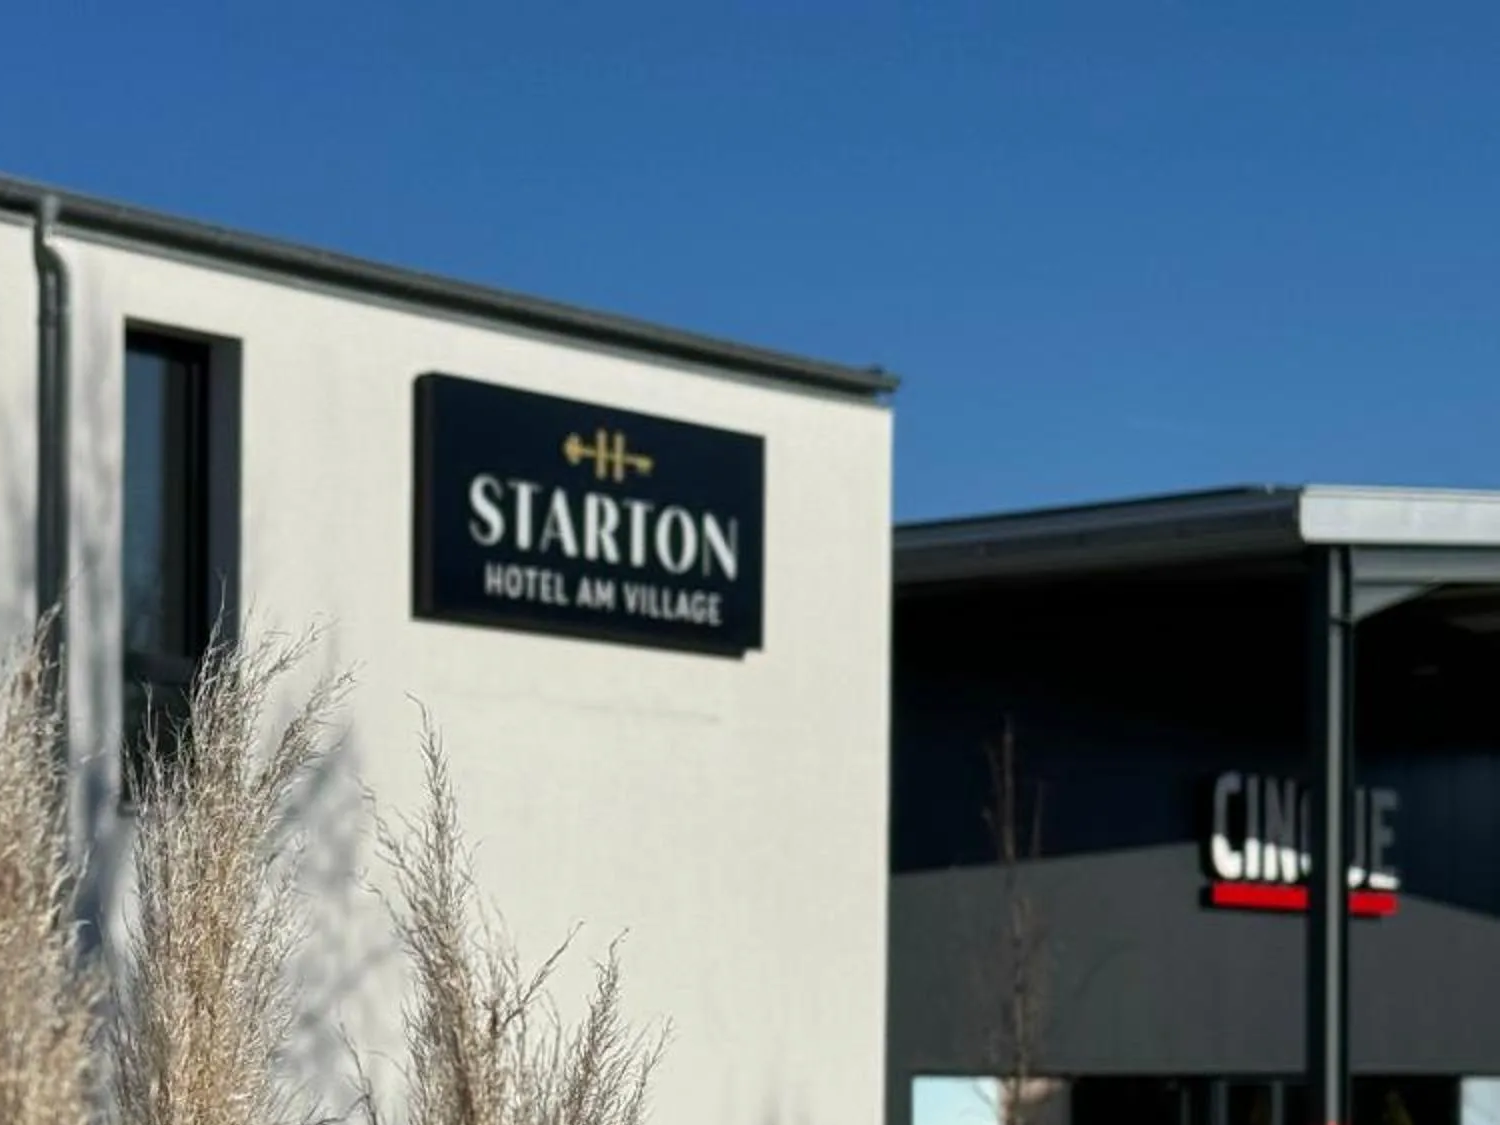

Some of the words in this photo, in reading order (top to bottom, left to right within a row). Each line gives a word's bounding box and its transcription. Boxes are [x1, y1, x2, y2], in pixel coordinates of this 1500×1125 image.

[468, 472, 738, 581] STARTON
[484, 561, 566, 606] HOTEL
[576, 575, 616, 612] AM
[623, 581, 722, 627] VILLAGE
